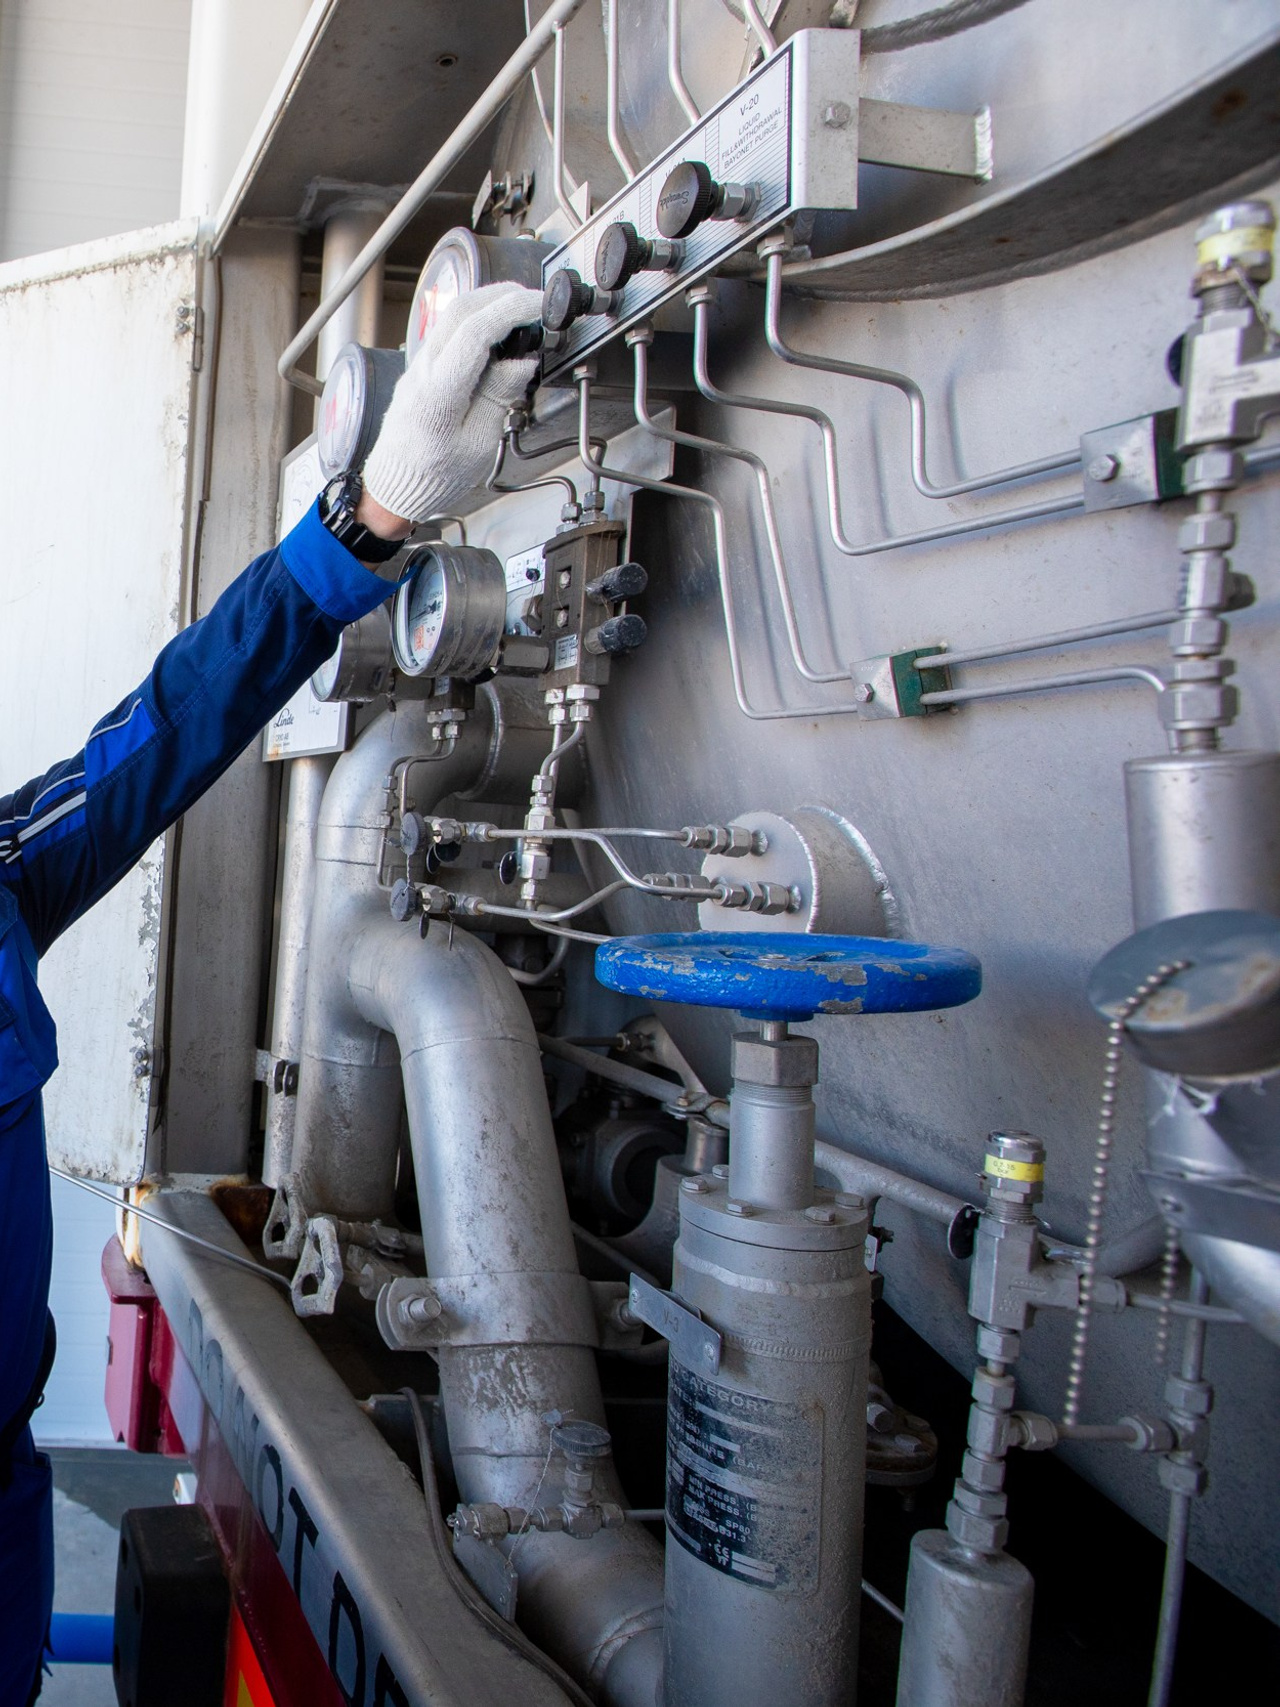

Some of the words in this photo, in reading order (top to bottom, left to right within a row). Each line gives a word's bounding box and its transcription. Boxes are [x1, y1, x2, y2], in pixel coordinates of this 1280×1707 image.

[740, 94, 759, 116] V-20
[738, 112, 760, 136] LIQUID
[724, 141, 753, 169] BAYONET
[754, 121, 779, 143] PURGE
[273, 708, 294, 728] Linde
